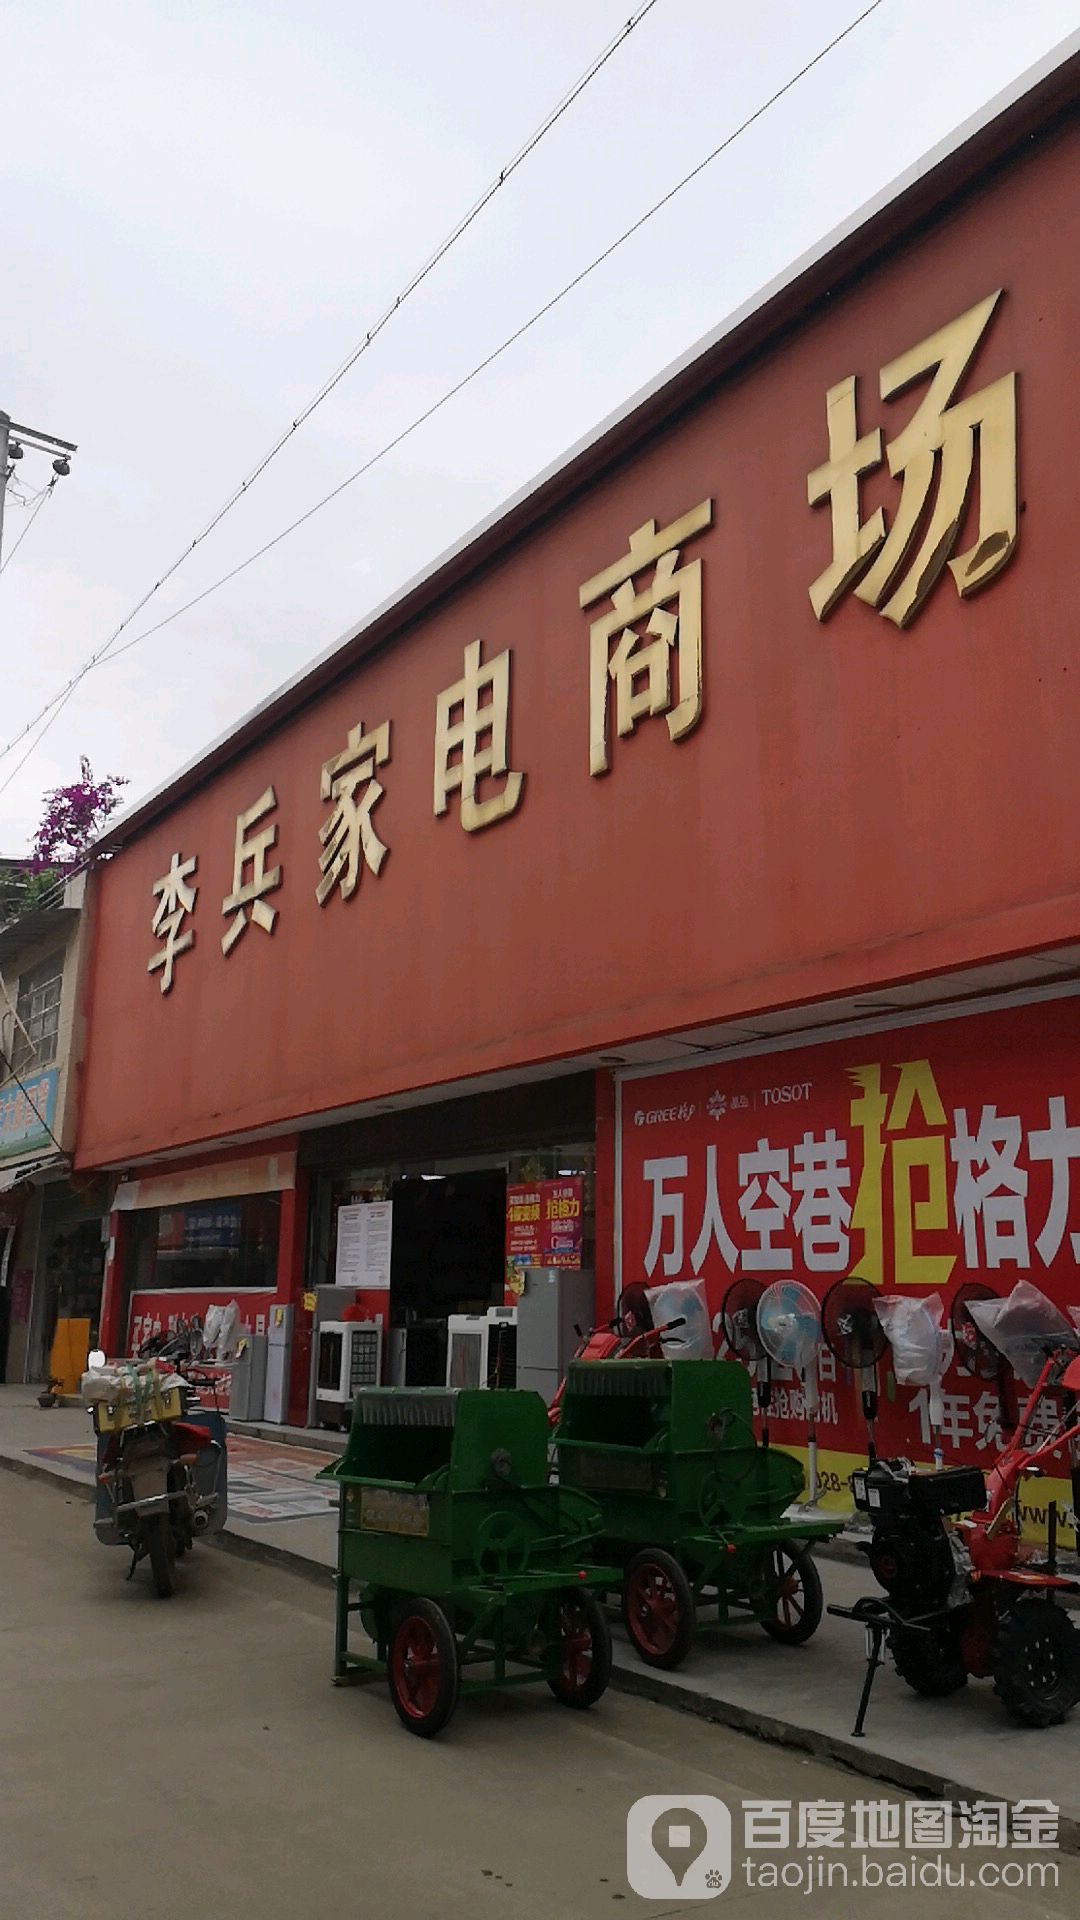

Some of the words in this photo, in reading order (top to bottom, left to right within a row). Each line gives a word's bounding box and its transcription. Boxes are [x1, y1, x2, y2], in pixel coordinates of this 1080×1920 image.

[147, 289, 1021, 995] 李兵家电商场
[761, 1083, 813, 1106] TOSOT
